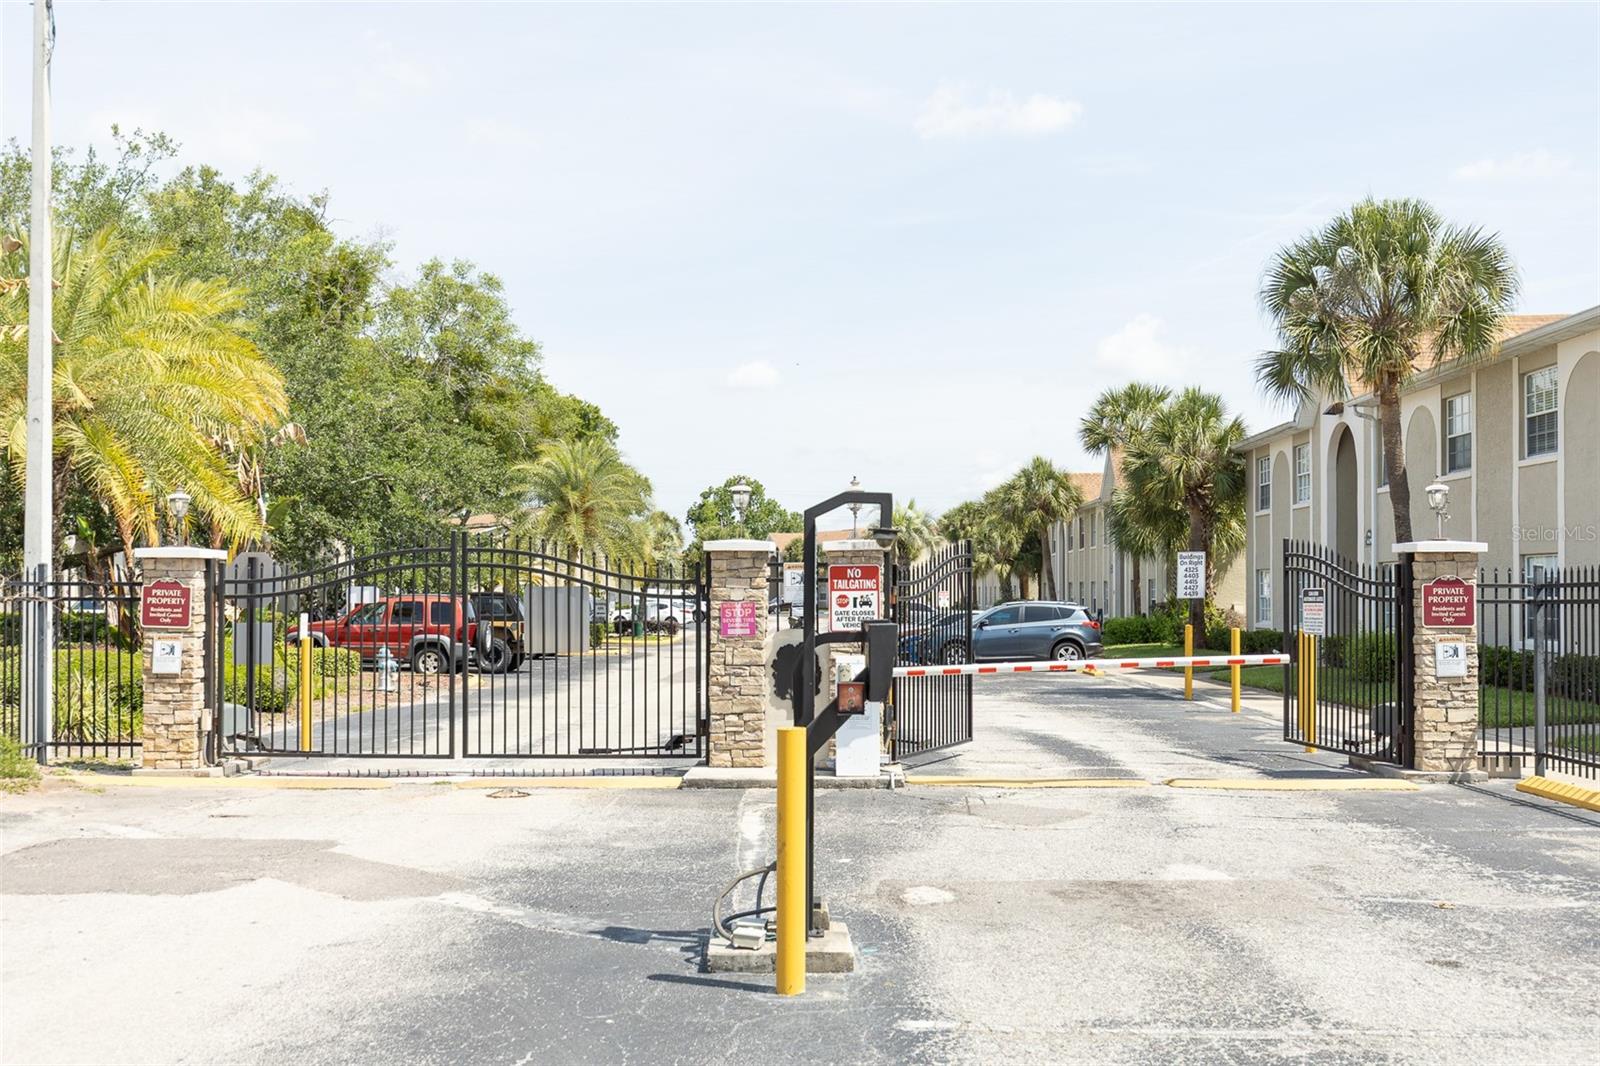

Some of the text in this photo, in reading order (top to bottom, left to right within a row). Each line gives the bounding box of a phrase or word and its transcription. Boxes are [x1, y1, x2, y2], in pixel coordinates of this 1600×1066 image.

[847, 568, 861, 578] NO
[832, 579, 877, 590] TAILGATING
[1432, 587, 1464, 595] PRIVATE
[147, 597, 186, 605] PROPERTY
[724, 608, 752, 617] STOP
